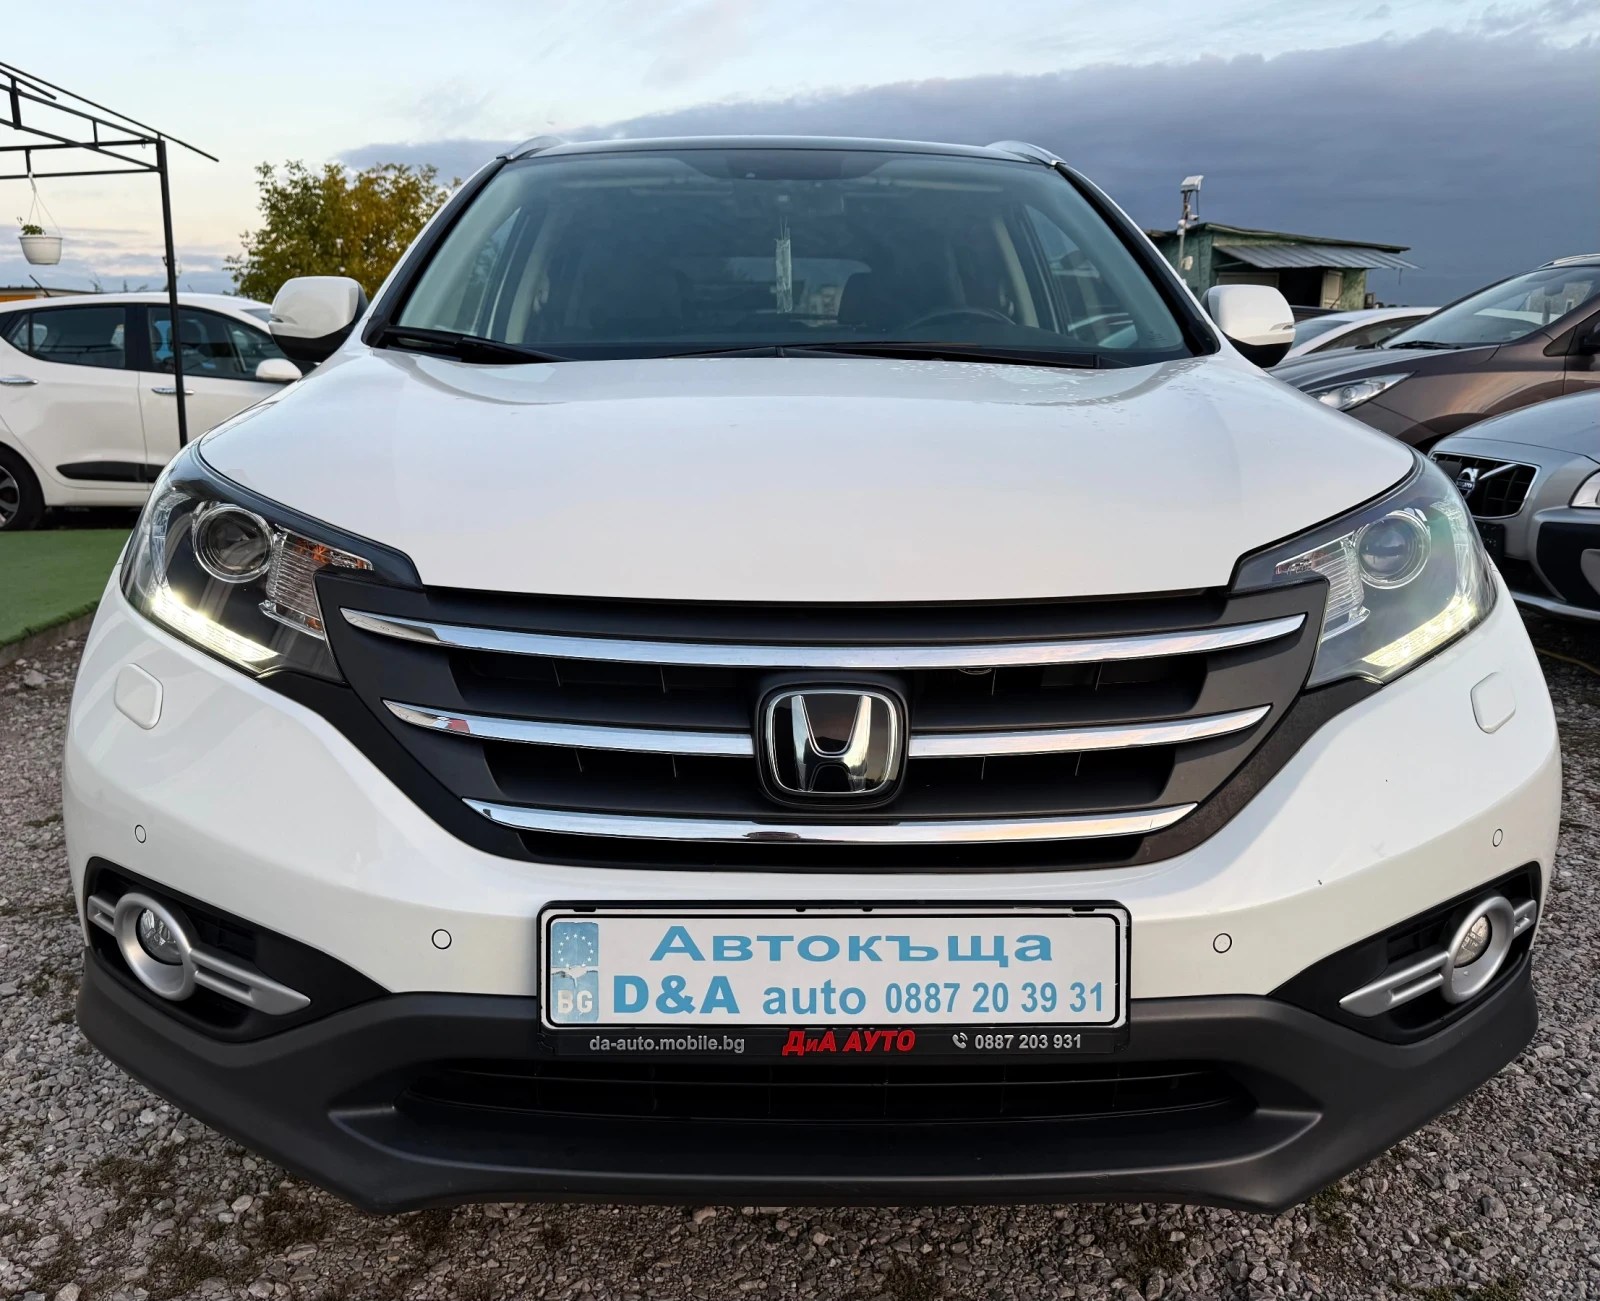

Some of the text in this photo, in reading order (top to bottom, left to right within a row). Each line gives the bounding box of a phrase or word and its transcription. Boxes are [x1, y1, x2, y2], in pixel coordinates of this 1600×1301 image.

[649, 925, 1053, 968] Автокъща
[557, 989, 593, 1014] BG
[613, 975, 1103, 1015] D&A auto 0887 20 39 31
[589, 1035, 745, 1053] da-auto.mobile.bg
[781, 1029, 916, 1056] ДиА АУТО
[974, 1033, 1082, 1049] 0887 203 931
